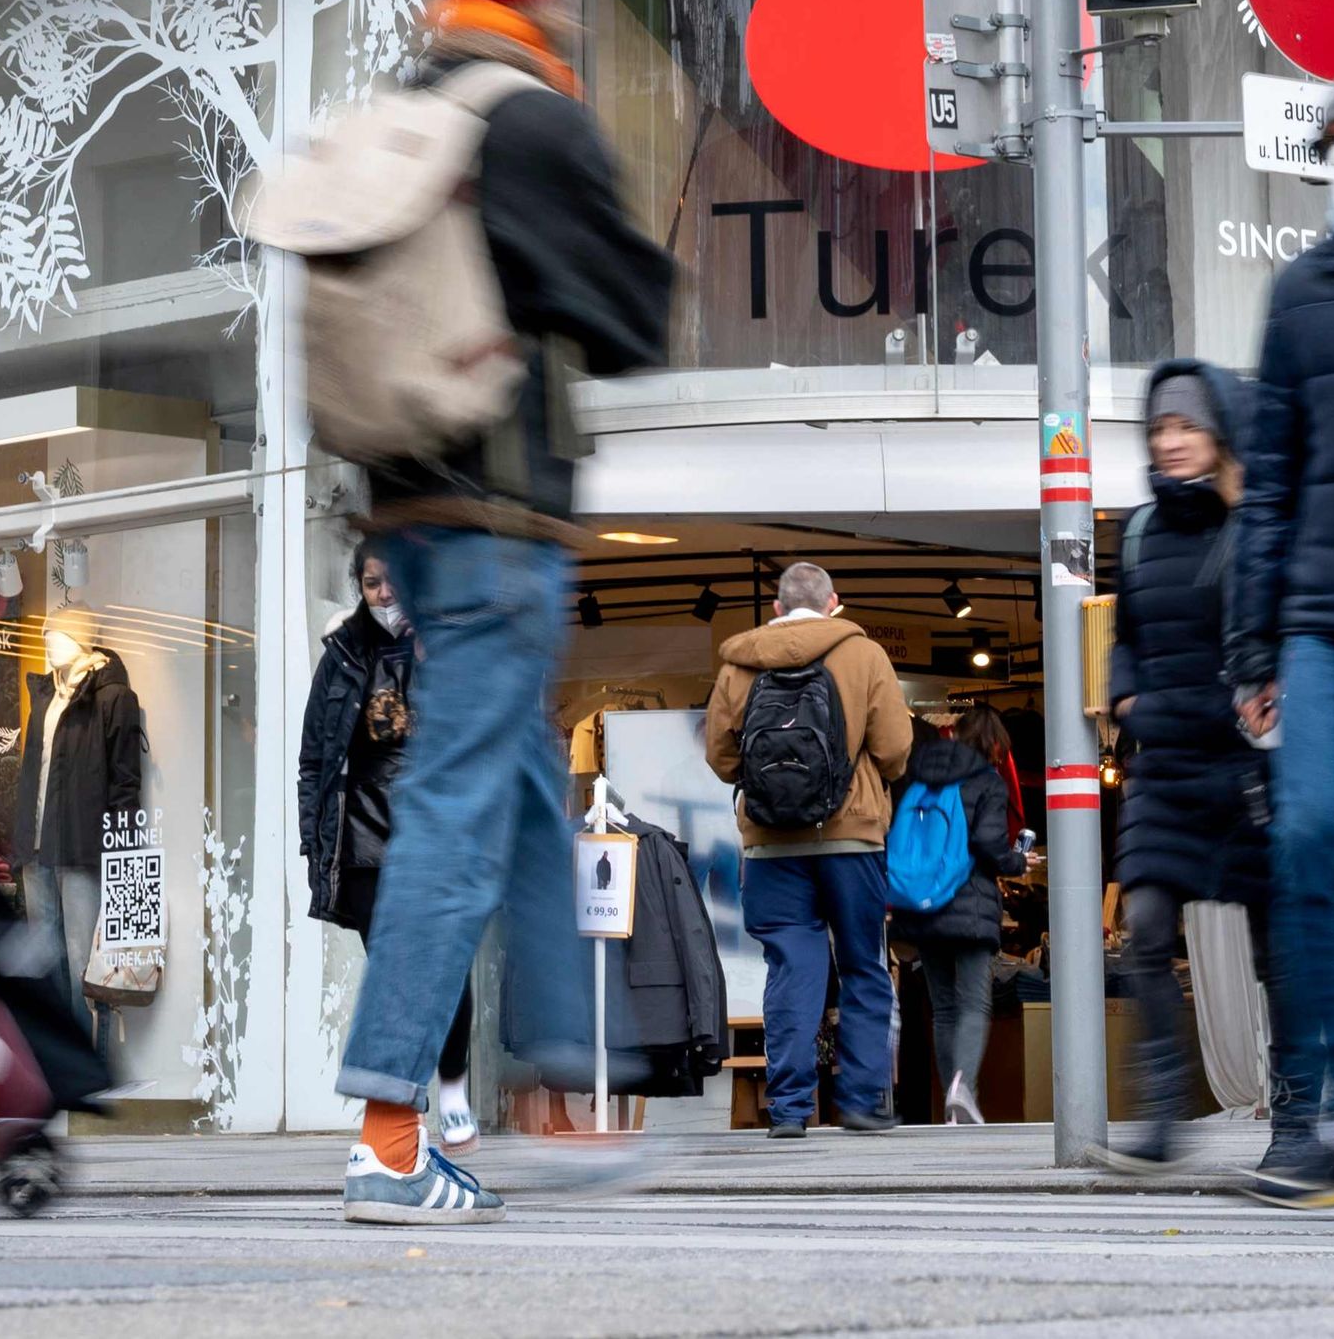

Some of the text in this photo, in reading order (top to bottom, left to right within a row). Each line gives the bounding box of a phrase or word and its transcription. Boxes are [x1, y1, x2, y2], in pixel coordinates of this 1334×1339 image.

[930, 93, 957, 124] U5
[1284, 100, 1326, 131] ausg
[1259, 144, 1271, 159] u.
[710, 198, 1134, 320] Turek
[102, 827, 163, 850] ONLINE!
[593, 905, 619, 918] 99,90
[102, 948, 161, 968] TUREK.AT
